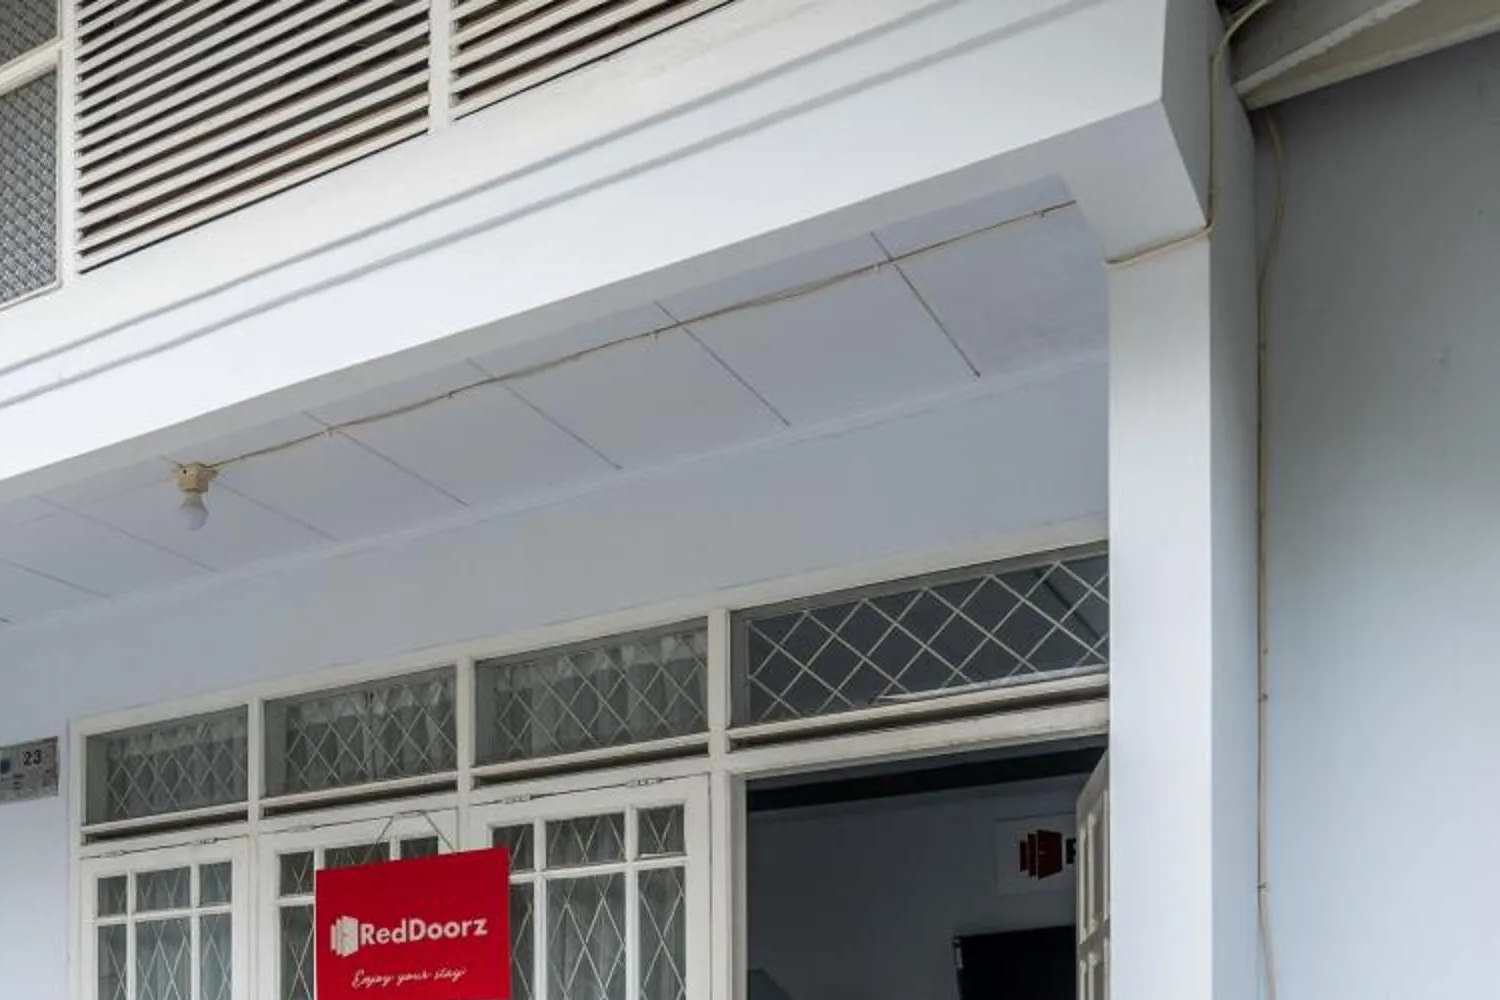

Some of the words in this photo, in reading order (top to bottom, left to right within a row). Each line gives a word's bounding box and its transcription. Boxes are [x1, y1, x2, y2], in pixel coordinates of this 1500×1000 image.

[360, 917, 488, 945] RedDoorz
[352, 969, 394, 988] Enjoy
[397, 971, 430, 986] your
